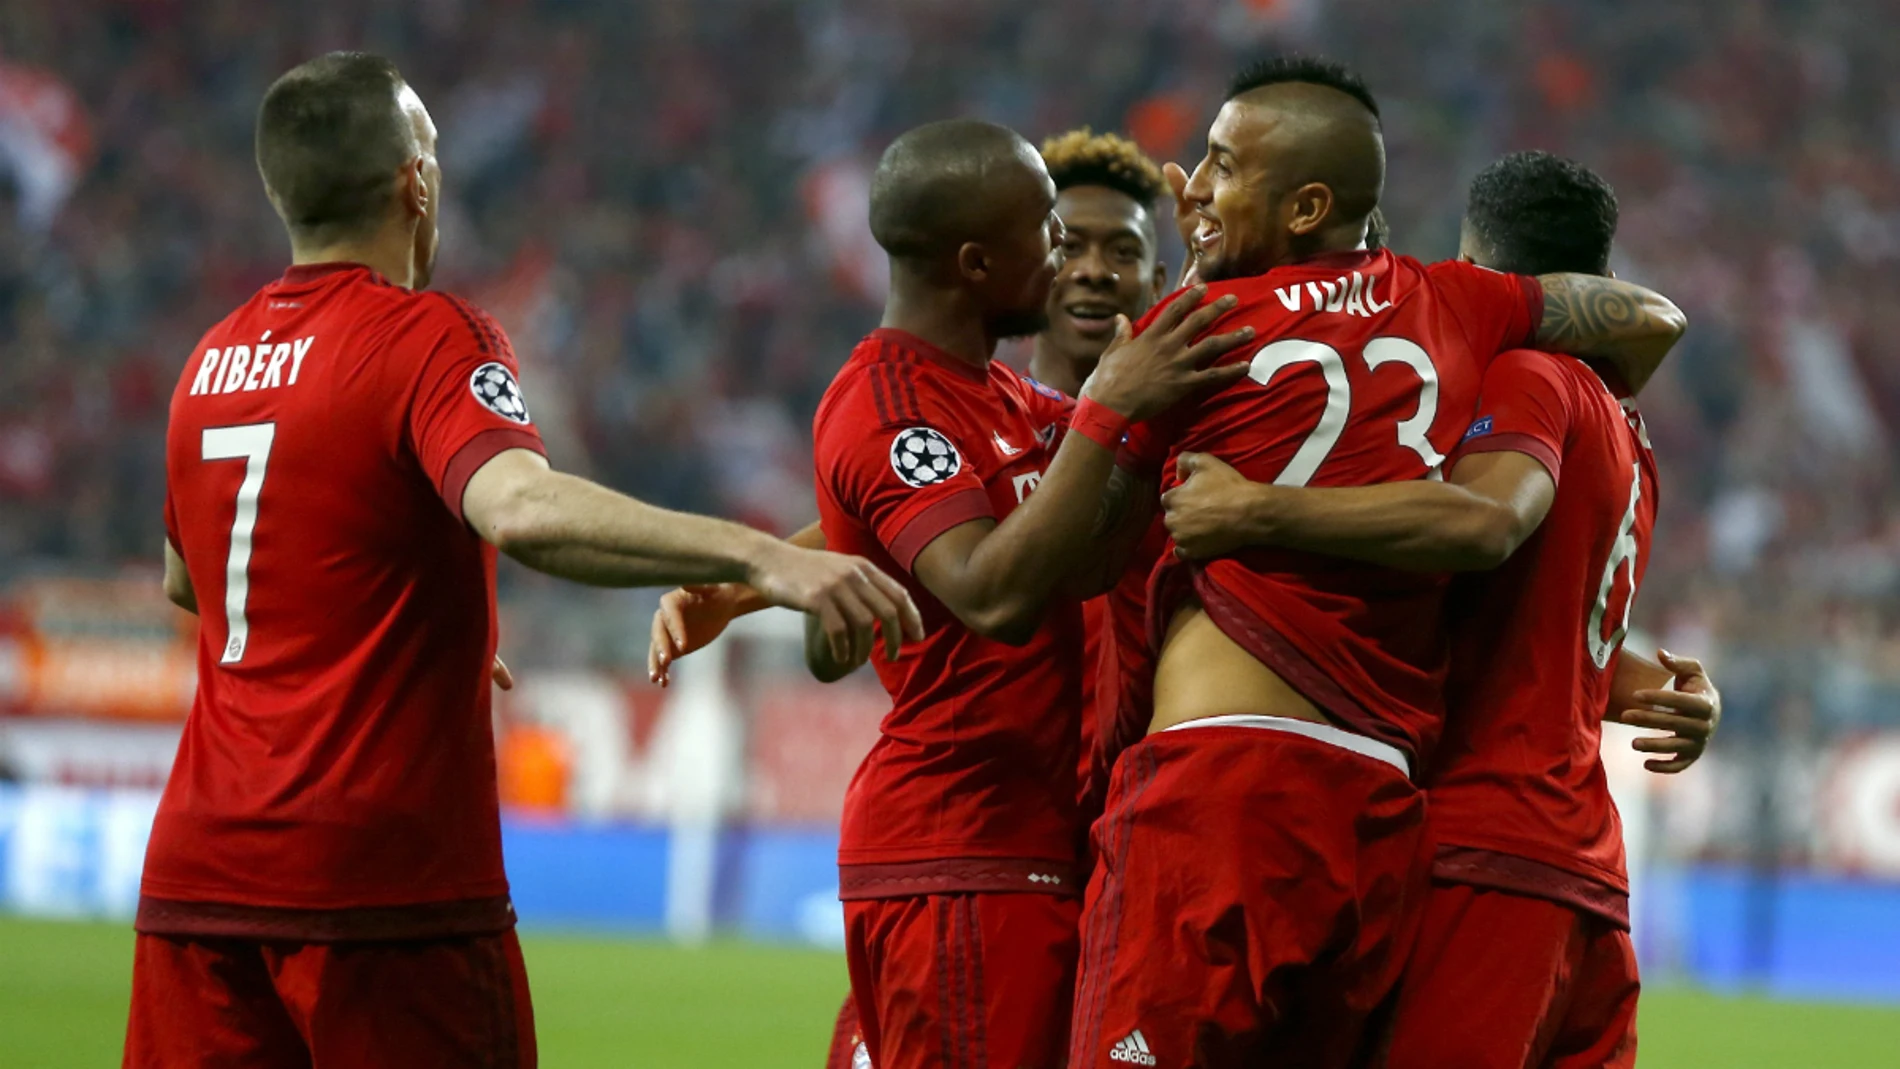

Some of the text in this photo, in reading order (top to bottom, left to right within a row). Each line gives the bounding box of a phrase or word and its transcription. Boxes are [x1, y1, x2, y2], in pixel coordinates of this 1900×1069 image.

[1274, 271, 1391, 318] VIDAL
[190, 329, 314, 396] RIBÉRY
[1248, 337, 1446, 487] 23
[201, 422, 276, 663] 7
[1588, 462, 1641, 669] 6
[1110, 1048, 1156, 1066] adidas
